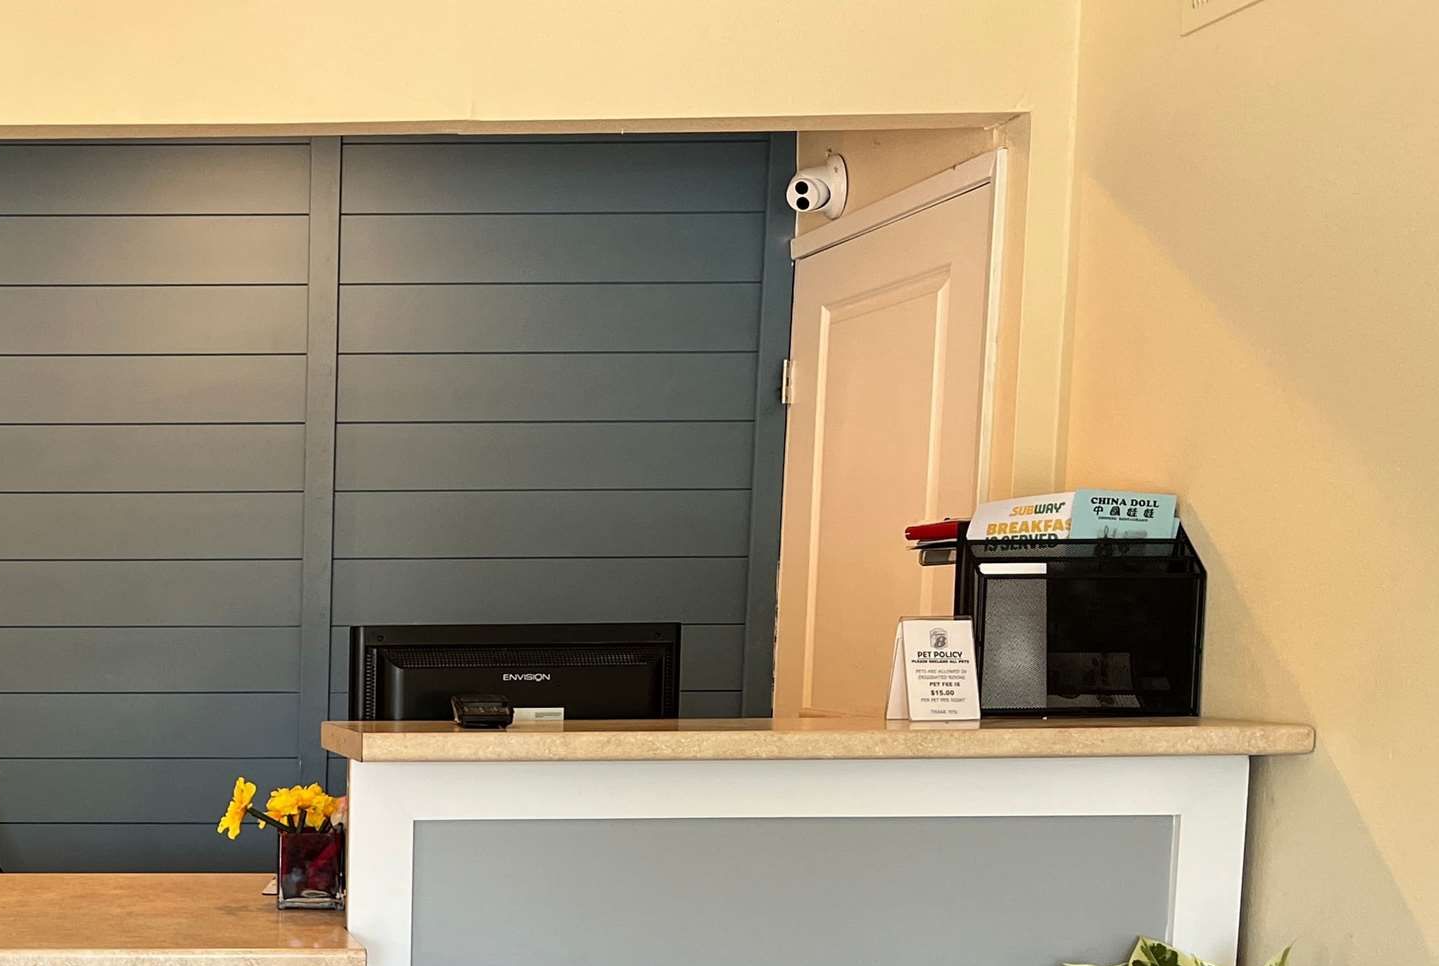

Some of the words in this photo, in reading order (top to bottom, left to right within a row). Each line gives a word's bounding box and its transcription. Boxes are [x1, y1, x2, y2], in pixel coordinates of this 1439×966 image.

[1091, 497, 1126, 506] CHINA
[1131, 499, 1159, 507] DOLL
[1010, 503, 1065, 516] SUBWAY
[987, 519, 1072, 535] BREAKFAS
